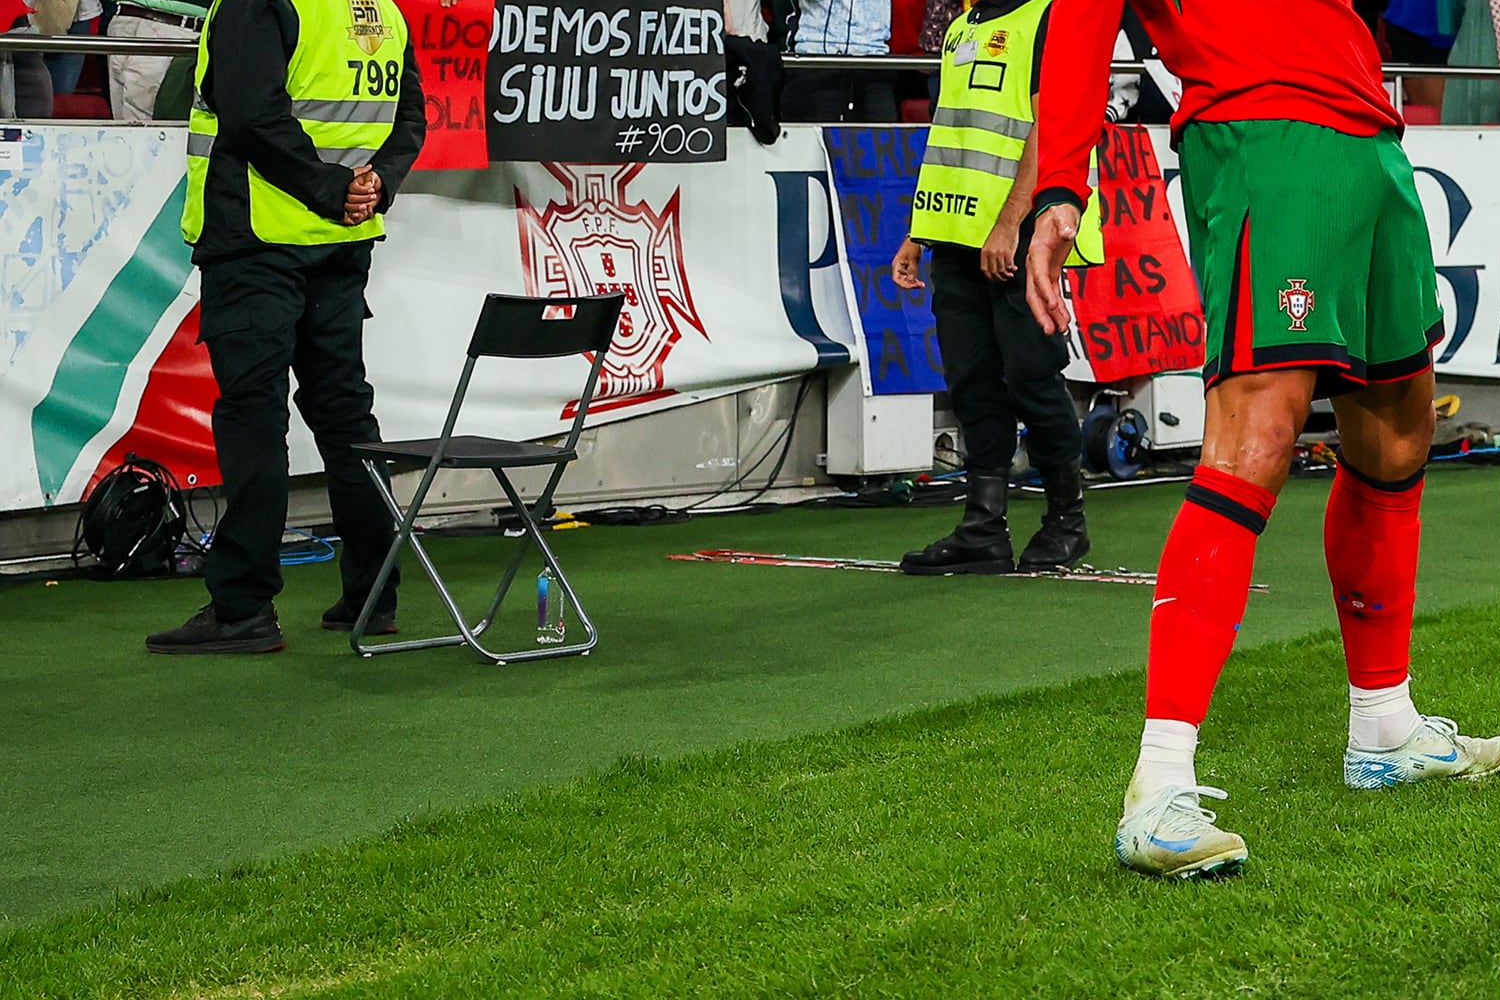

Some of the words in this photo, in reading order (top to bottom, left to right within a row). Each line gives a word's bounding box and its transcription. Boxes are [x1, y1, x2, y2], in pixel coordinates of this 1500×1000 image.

[637, 6, 726, 56] FAZER
[346, 59, 400, 97] 798
[614, 122, 714, 157] #900
[1115, 254, 1167, 298] AS
